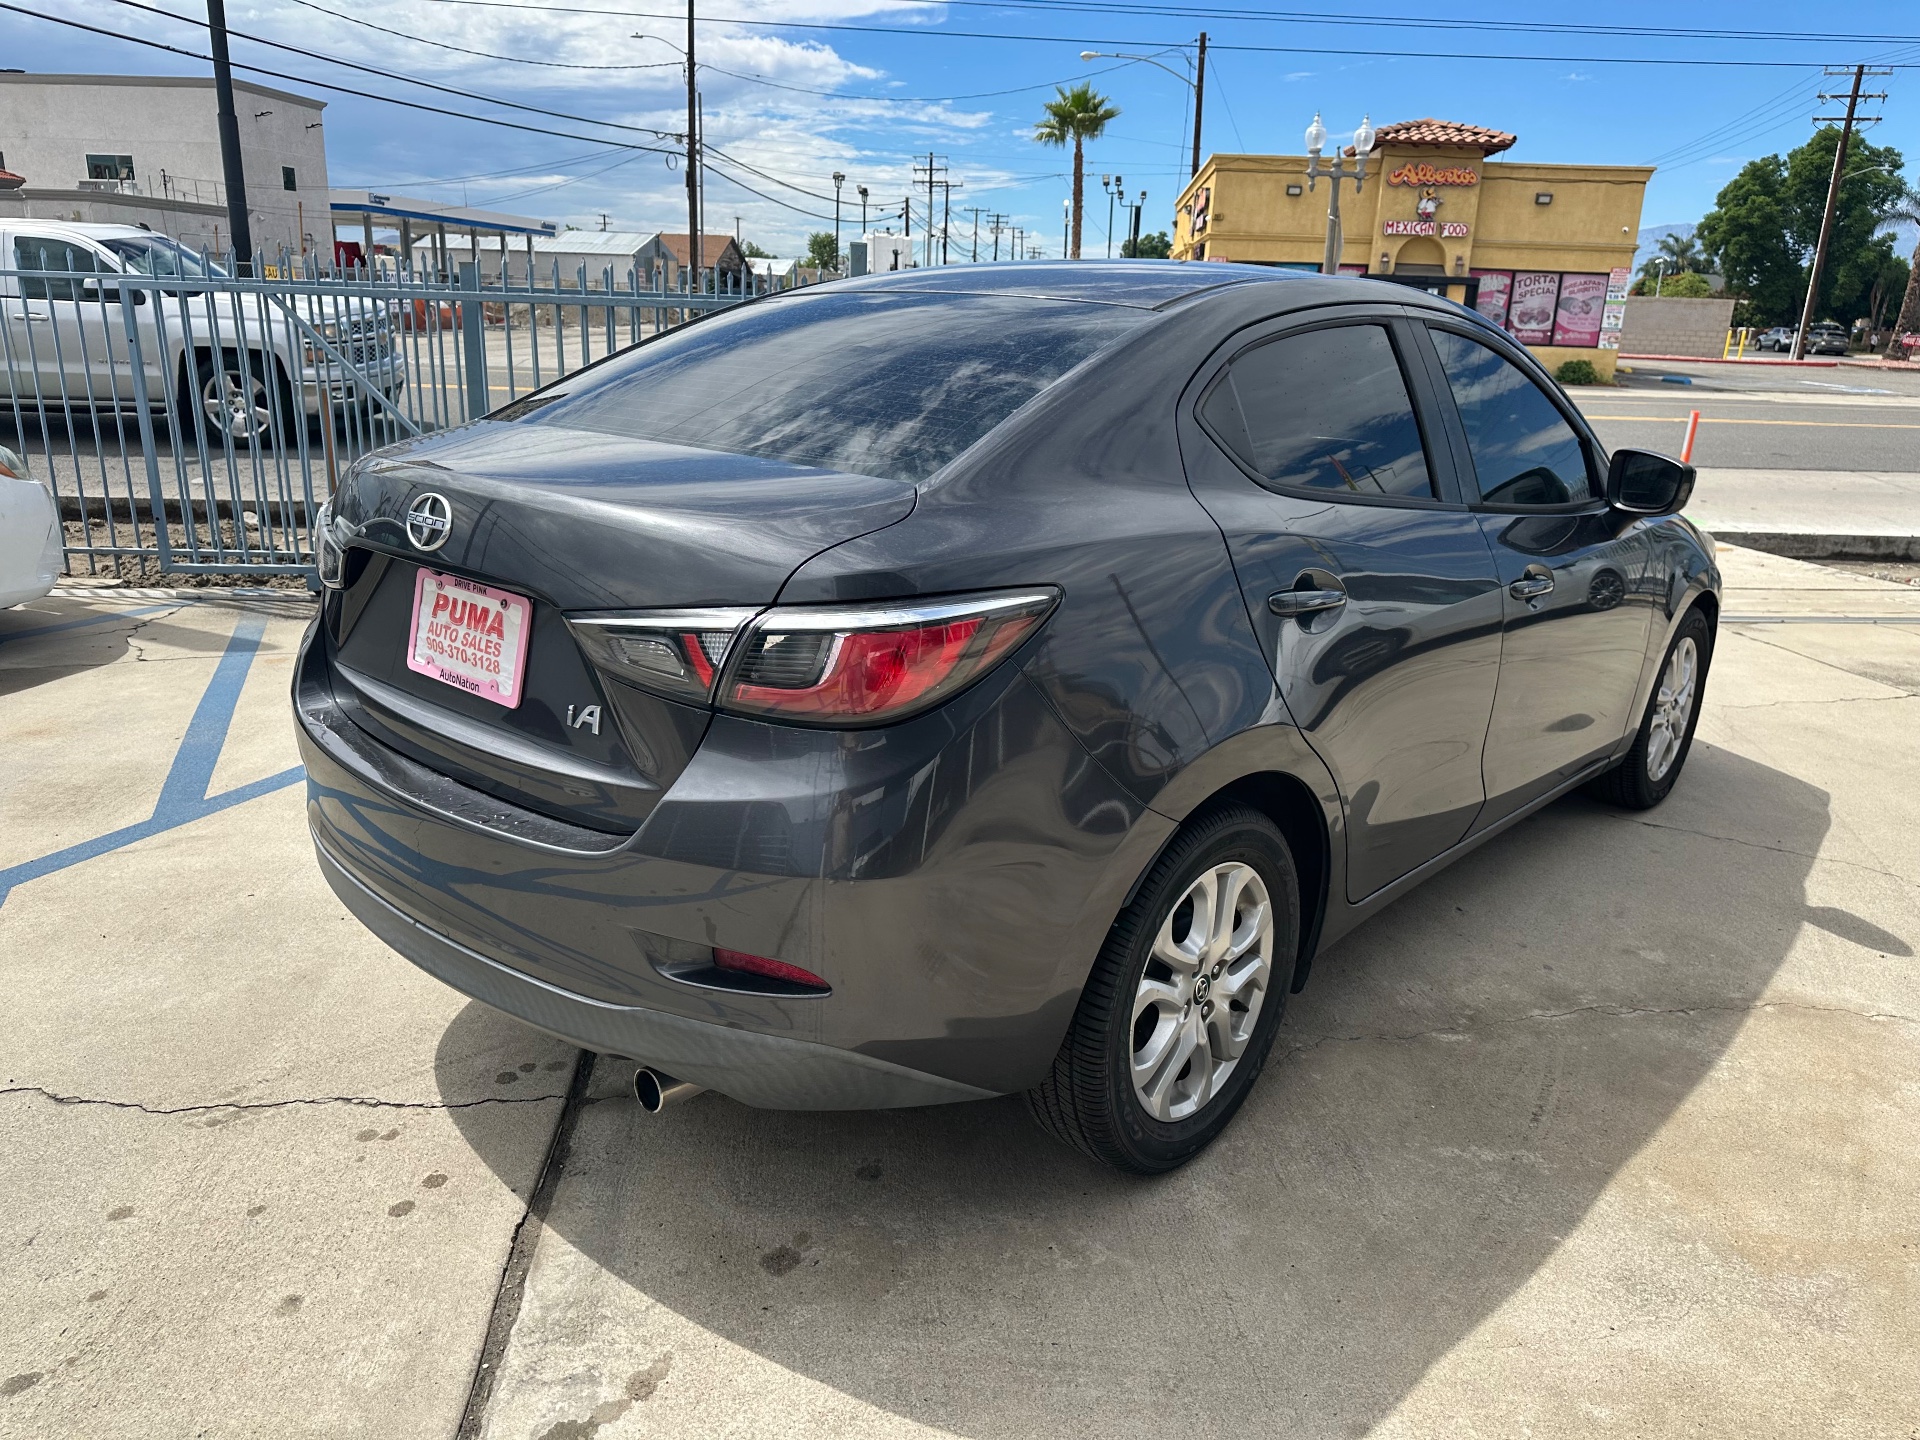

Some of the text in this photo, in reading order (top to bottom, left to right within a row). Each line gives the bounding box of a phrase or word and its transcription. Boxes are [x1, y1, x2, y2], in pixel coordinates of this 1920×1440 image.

[1384, 221, 1469, 237] MEXICAN FOOD
[1517, 274, 1556, 289] TORTA
[1518, 287, 1555, 299] SPECIAL
[454, 578, 488, 595] DRIVE PINK
[431, 593, 505, 640] PUMA
[427, 621, 502, 657] AUTO SALES
[426, 636, 500, 674] 909-370-3128
[439, 669, 480, 693] AutoNation
